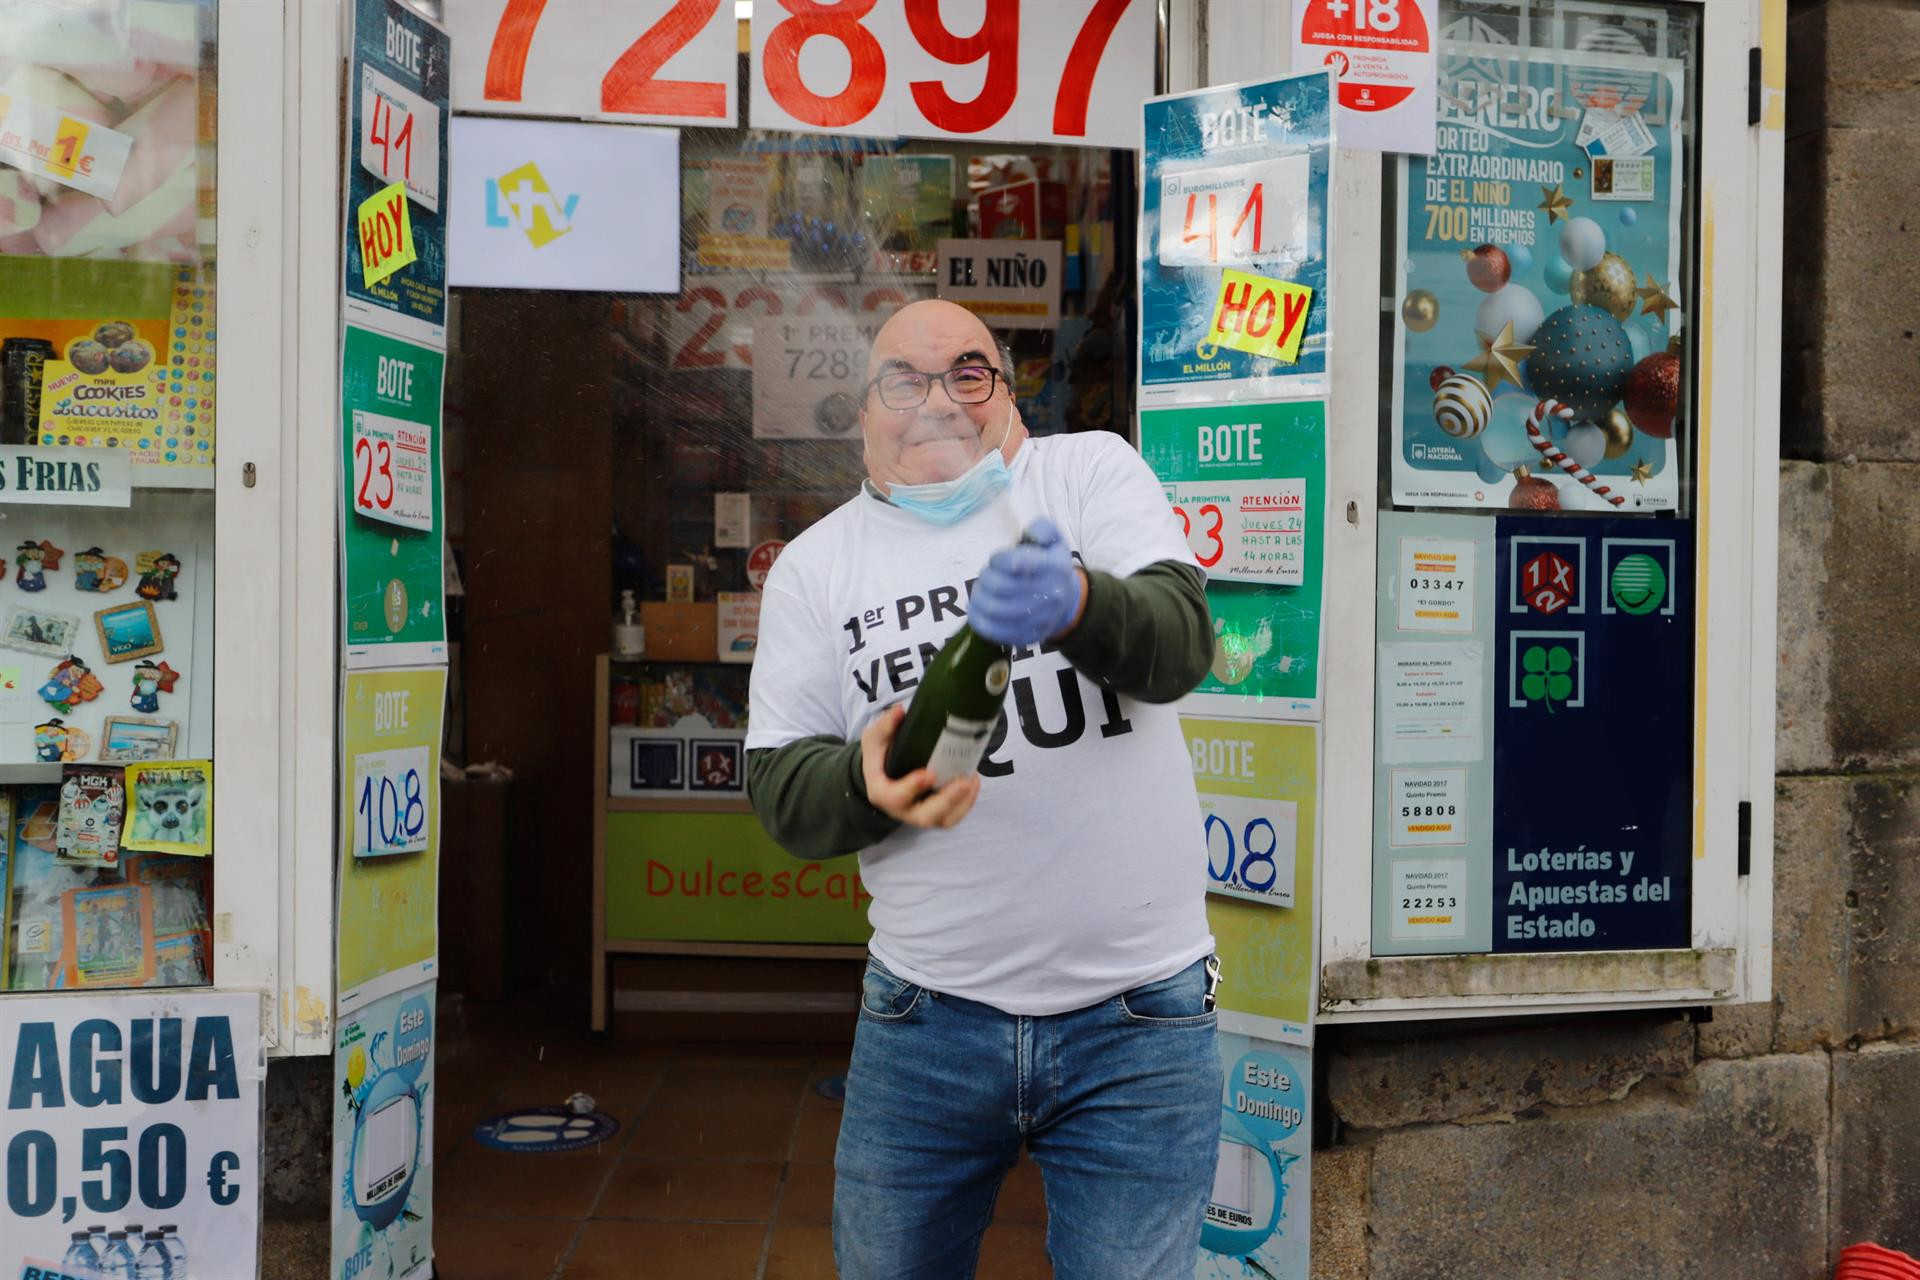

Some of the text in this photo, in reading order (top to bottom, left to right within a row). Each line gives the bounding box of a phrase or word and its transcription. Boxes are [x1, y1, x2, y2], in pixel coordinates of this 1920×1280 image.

[1327, 0, 1400, 32] +18
[387, 16, 421, 75] BOTE
[1312, 32, 1335, 41] JUEGA
[1354, 35, 1419, 46] RESPONSABILIDAD
[1362, 63, 1383, 71] VENTA
[371, 94, 413, 182] 41
[1202, 104, 1268, 149] BOTE
[1438, 126, 1489, 152] ORTEO
[56, 136, 78, 164] 1
[79, 156, 96, 174] €
[1426, 153, 1564, 184] EXTRAORDINARIO
[1183, 178, 1245, 194] EUROMILLONES
[1426, 178, 1511, 206] DE EL NIÑO
[361, 194, 403, 268] HOY
[1184, 183, 1263, 263] 41
[1424, 204, 1536, 241] 700 MILLONES
[1470, 227, 1536, 246] EN PREMIOS
[949, 257, 977, 287] EL
[987, 252, 1047, 288] NIÑO
[371, 284, 379, 294] EL
[379, 286, 399, 301] MILLÓN
[1217, 282, 1306, 348] HOY
[378, 355, 414, 402] BOTE
[1183, 360, 1231, 374] EL MILLÓN
[48, 373, 79, 391] NUEVO
[94, 378, 116, 386] mini
[52, 398, 159, 420] Lacasitos
[398, 430, 427, 446] ATENCIÓN
[1198, 424, 1262, 462] BOTE
[1427, 446, 1456, 454] LOTERÍA
[1427, 453, 1463, 461] NACIONAL
[16, 456, 101, 492] FRIAS
[356, 438, 394, 510] 23
[1179, 495, 1231, 504] LA PRIMITIVA
[1242, 491, 1300, 506] ATENCIÓN
[1288, 517, 1303, 529] 24
[1242, 535, 1303, 546] HASTA LAS
[1243, 551, 1295, 561] 14 HORAS
[1230, 566, 1298, 575] Millones de Euros
[1410, 578, 1464, 590] 03347
[843, 606, 885, 655] 1er
[375, 690, 410, 730] BOTE
[1192, 738, 1255, 777] BOTE
[81, 775, 108, 786] MGK
[1402, 806, 1456, 817] 58808
[1507, 845, 1635, 876] Loterías y
[1403, 898, 1456, 908] 22253
[1507, 877, 1670, 911] Apuestas del
[1507, 912, 1595, 939] Estado
[401, 1008, 425, 1033] Este
[8, 1016, 240, 1109] AGUA
[397, 1038, 430, 1066] Domingo
[1245, 1062, 1291, 1091] Este
[1237, 1091, 1302, 1129] Domingo
[7, 1122, 240, 1223] 0,50 €
[367, 1168, 407, 1200] MILLONES DE EUROS
[1218, 1208, 1227, 1219] DE
[1229, 1212, 1253, 1226] EUROS
[345, 1243, 373, 1280] BOTE
